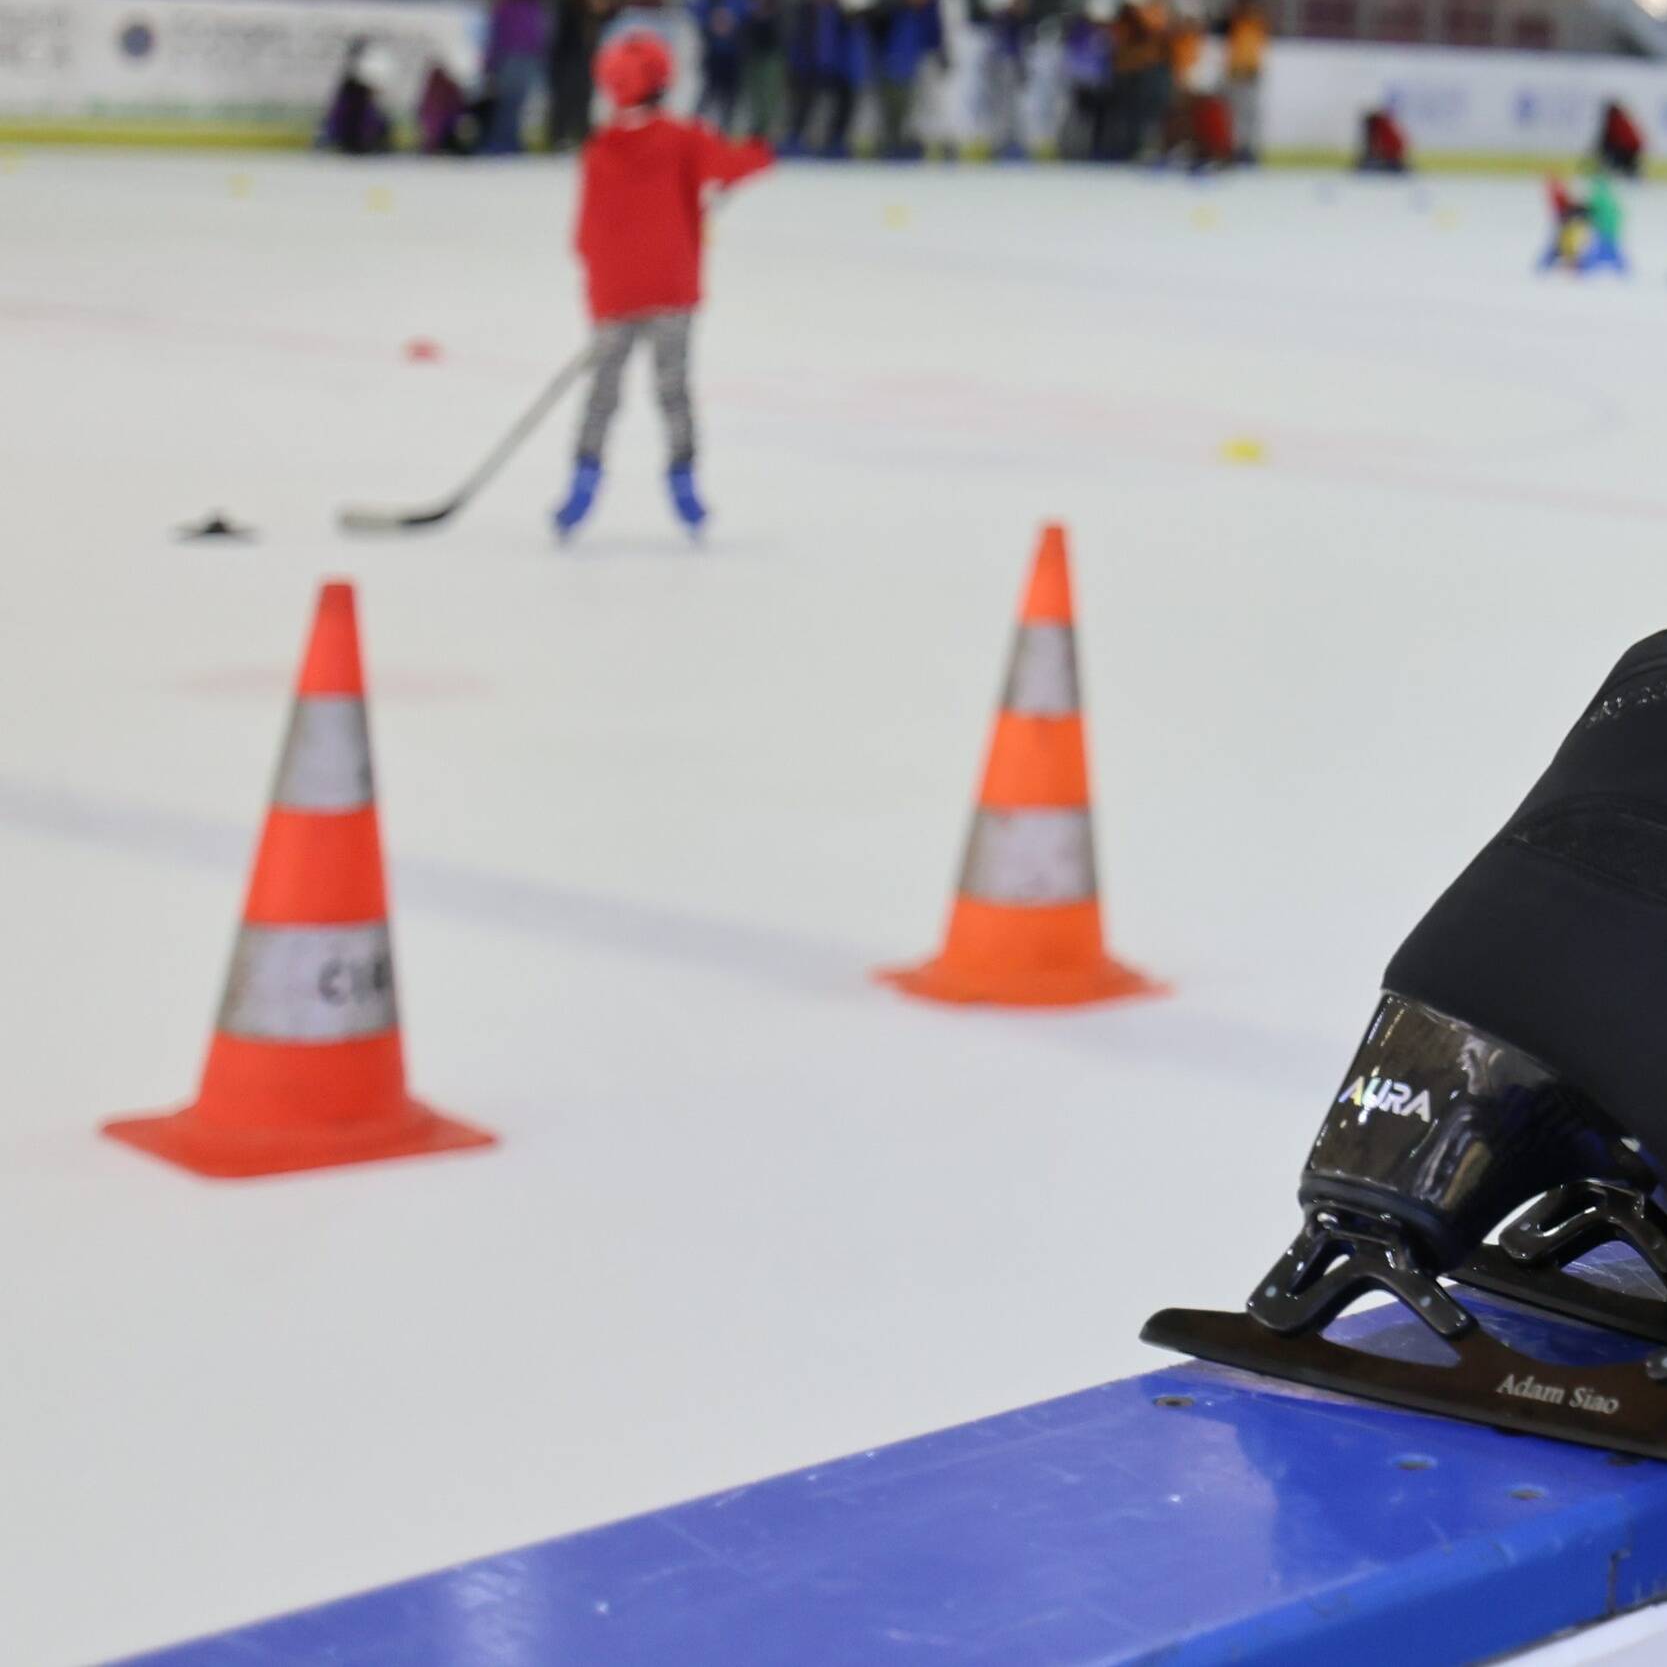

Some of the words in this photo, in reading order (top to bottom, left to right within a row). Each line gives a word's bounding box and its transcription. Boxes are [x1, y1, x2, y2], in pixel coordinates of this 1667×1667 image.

[1338, 1075, 1431, 1124] AURA
[1496, 1373, 1565, 1405] Adam
[1568, 1387, 1620, 1414] Siao
